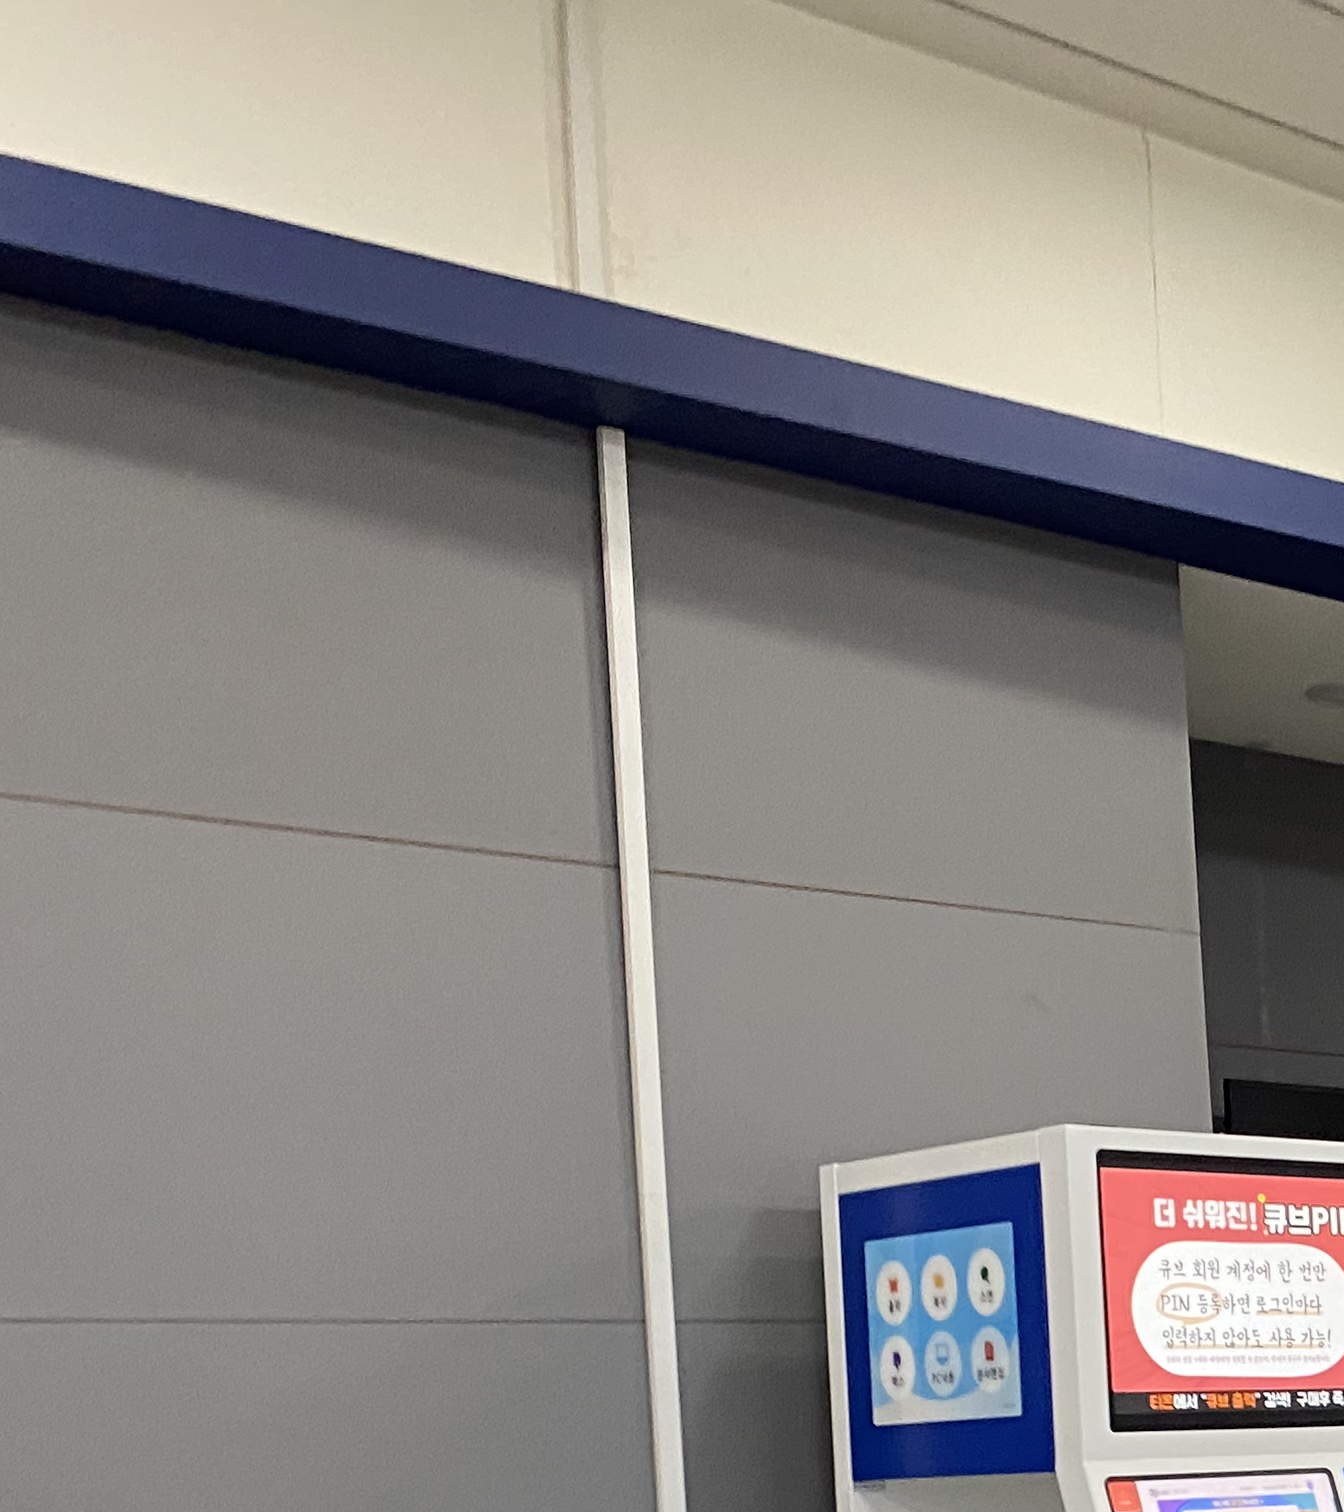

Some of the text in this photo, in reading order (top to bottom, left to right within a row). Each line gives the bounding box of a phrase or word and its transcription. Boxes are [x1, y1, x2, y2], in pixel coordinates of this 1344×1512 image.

[1154, 1198, 1175, 1228] 더
[1182, 1200, 1257, 1231] 쉬워진!
[1159, 1258, 1327, 1283] 큐브 회원 계정에 한 번만
[1160, 1293, 1322, 1314] PIN 등록하면 로그인마다
[1162, 1326, 1216, 1348] 입력하지
[1269, 1327, 1295, 1348] 사용
[1301, 1327, 1332, 1348] 가능!
